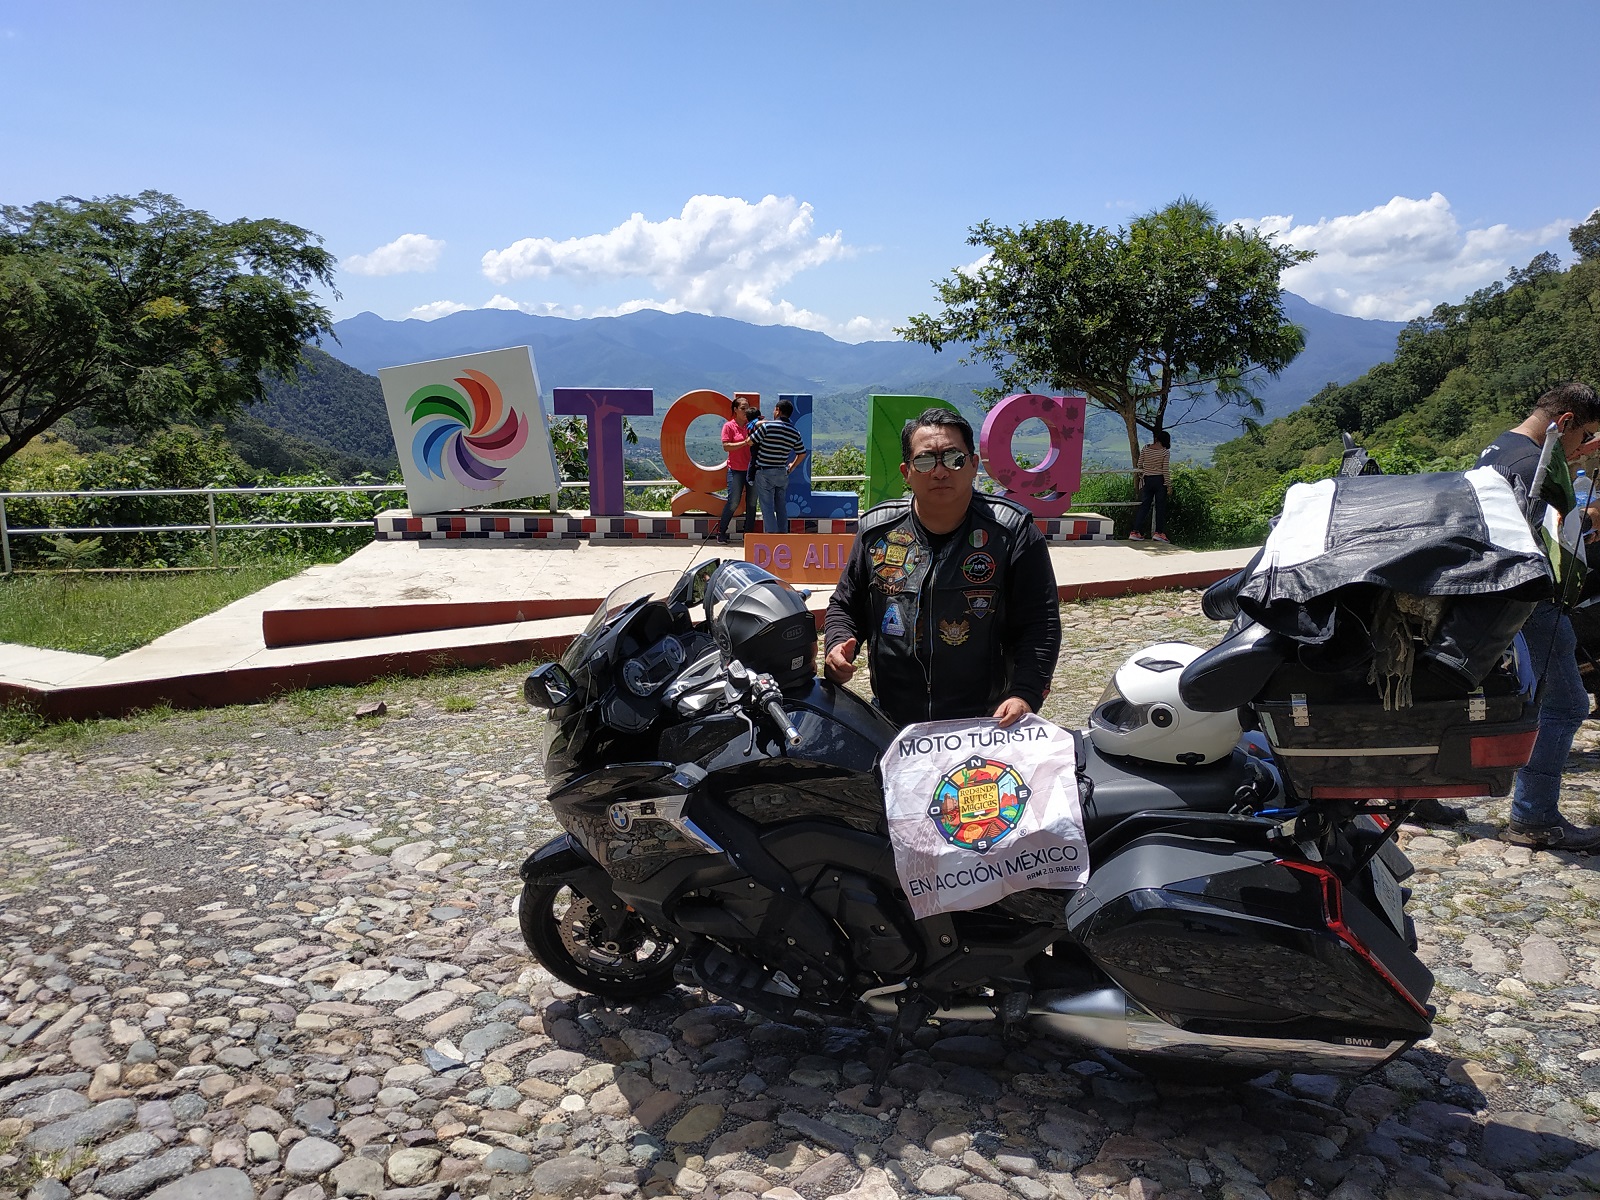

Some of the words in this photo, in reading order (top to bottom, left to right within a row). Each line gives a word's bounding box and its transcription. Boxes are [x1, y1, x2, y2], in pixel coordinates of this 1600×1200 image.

[803, 543, 848, 569] ALL
[898, 734, 962, 758] MOTO
[967, 726, 1049, 749] TURISTA
[970, 759, 982, 767] N
[1018, 789, 1028, 798] E
[977, 840, 987, 850] S
[908, 876, 933, 897] EN
[935, 859, 1002, 892] ACCIÓN
[1005, 845, 1079, 876] MÉXICO
[1026, 870, 1043, 881] RRM
[1344, 1037, 1373, 1047] BMW
